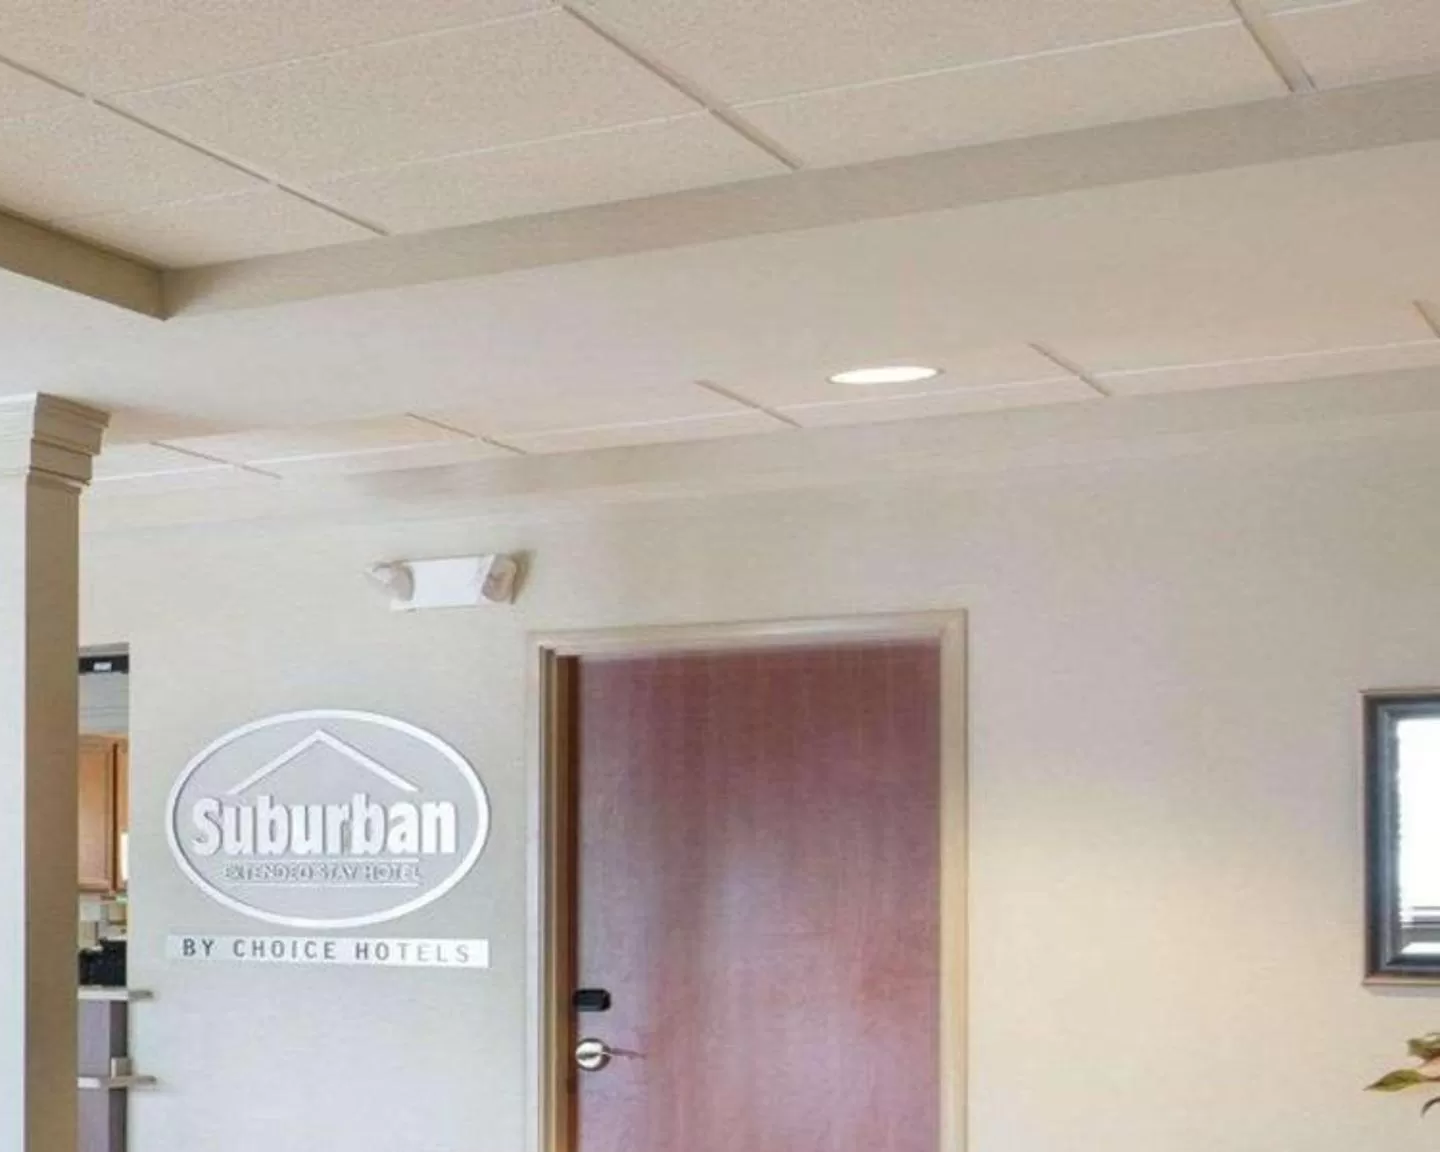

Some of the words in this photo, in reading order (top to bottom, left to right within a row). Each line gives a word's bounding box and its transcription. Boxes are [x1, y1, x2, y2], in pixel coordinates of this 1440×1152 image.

[192, 794, 456, 855] Suburban
[313, 862, 358, 881] STAY
[364, 862, 420, 882] HOTEL
[182, 939, 215, 957] BY
[233, 939, 337, 960] CHOICE
[355, 942, 470, 964] HOTELS
